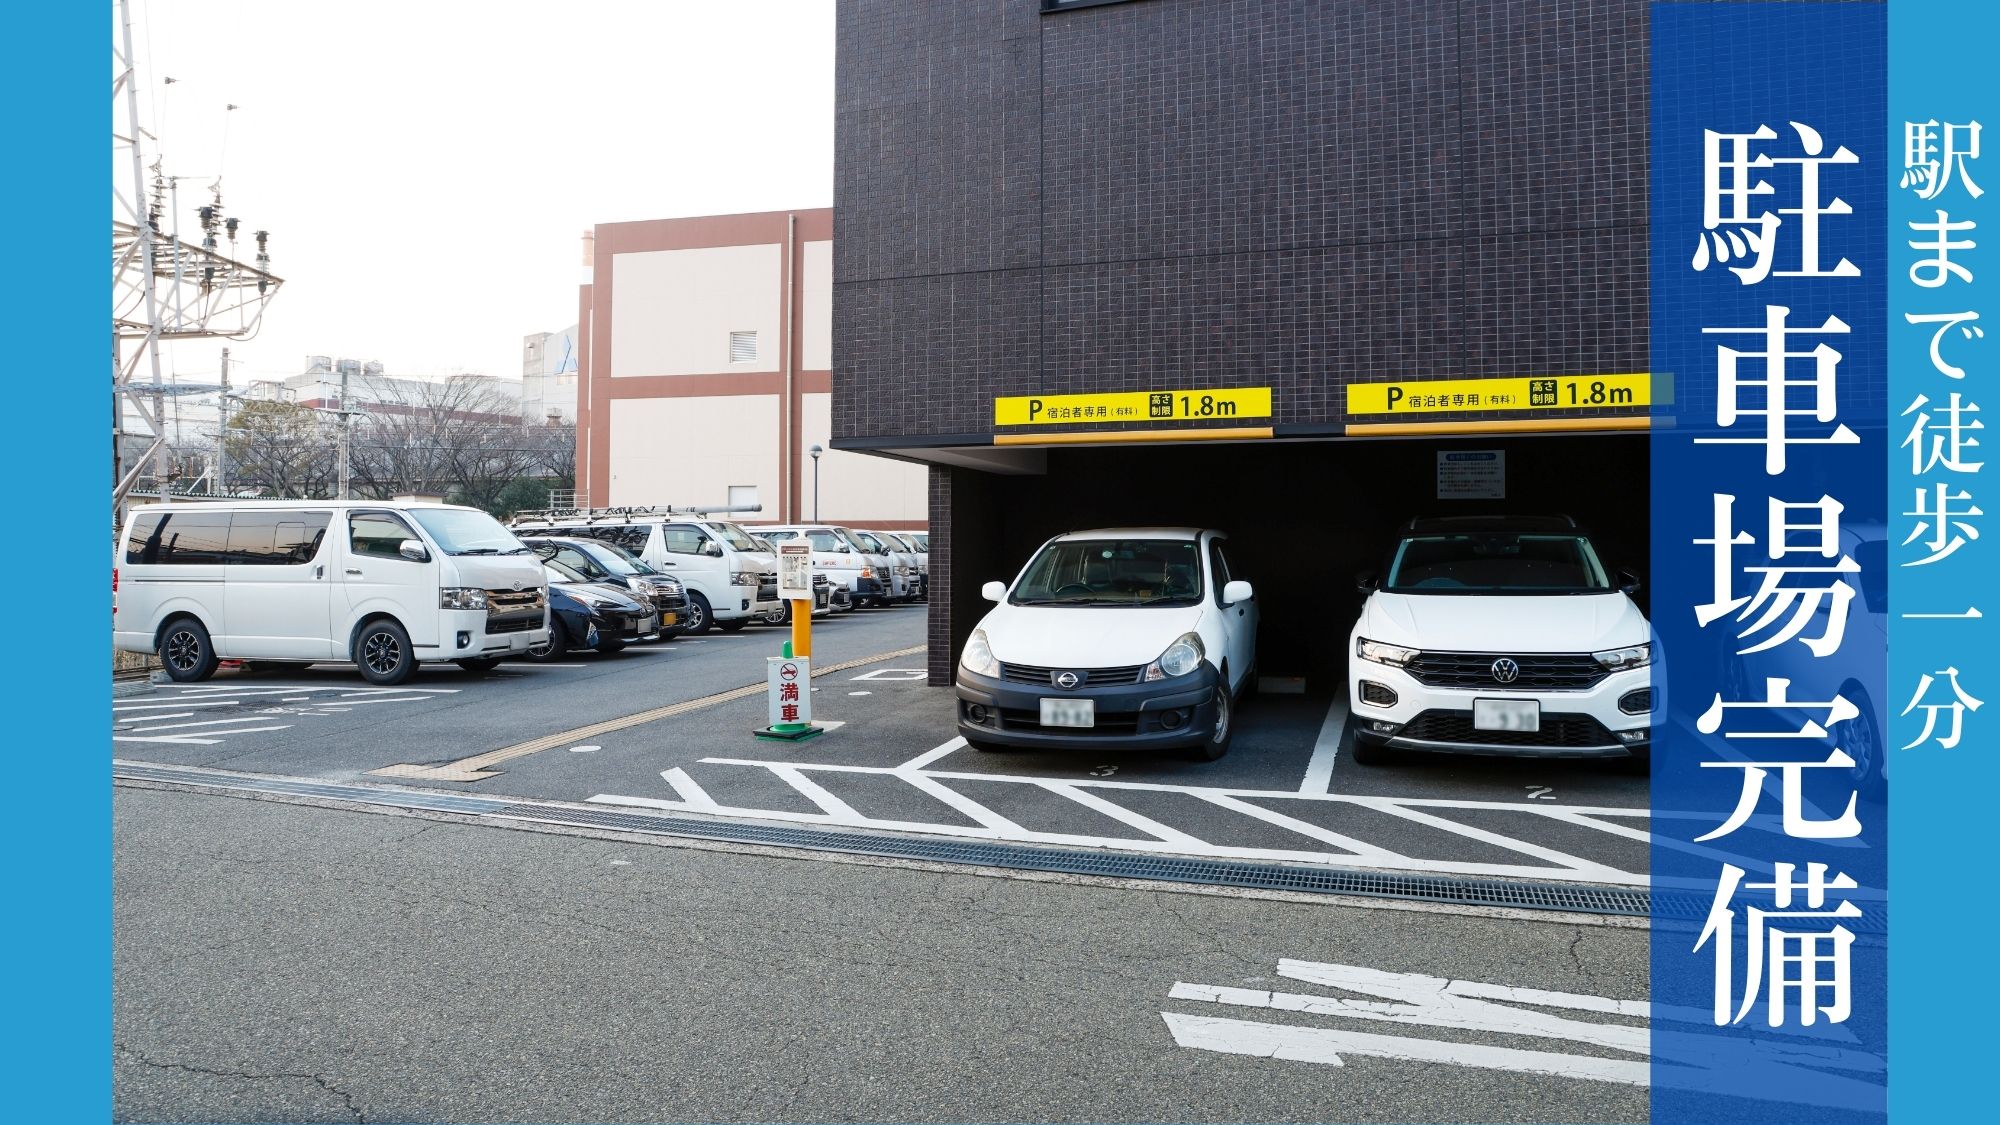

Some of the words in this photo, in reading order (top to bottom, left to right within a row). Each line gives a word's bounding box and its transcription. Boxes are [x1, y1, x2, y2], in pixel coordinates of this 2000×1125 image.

[1387, 386, 1404, 411] P
[1566, 381, 1633, 405] 1.8m
[1029, 399, 1043, 422] P
[1180, 395, 1237, 417] 1.8m
[779, 682, 800, 723] 満車
